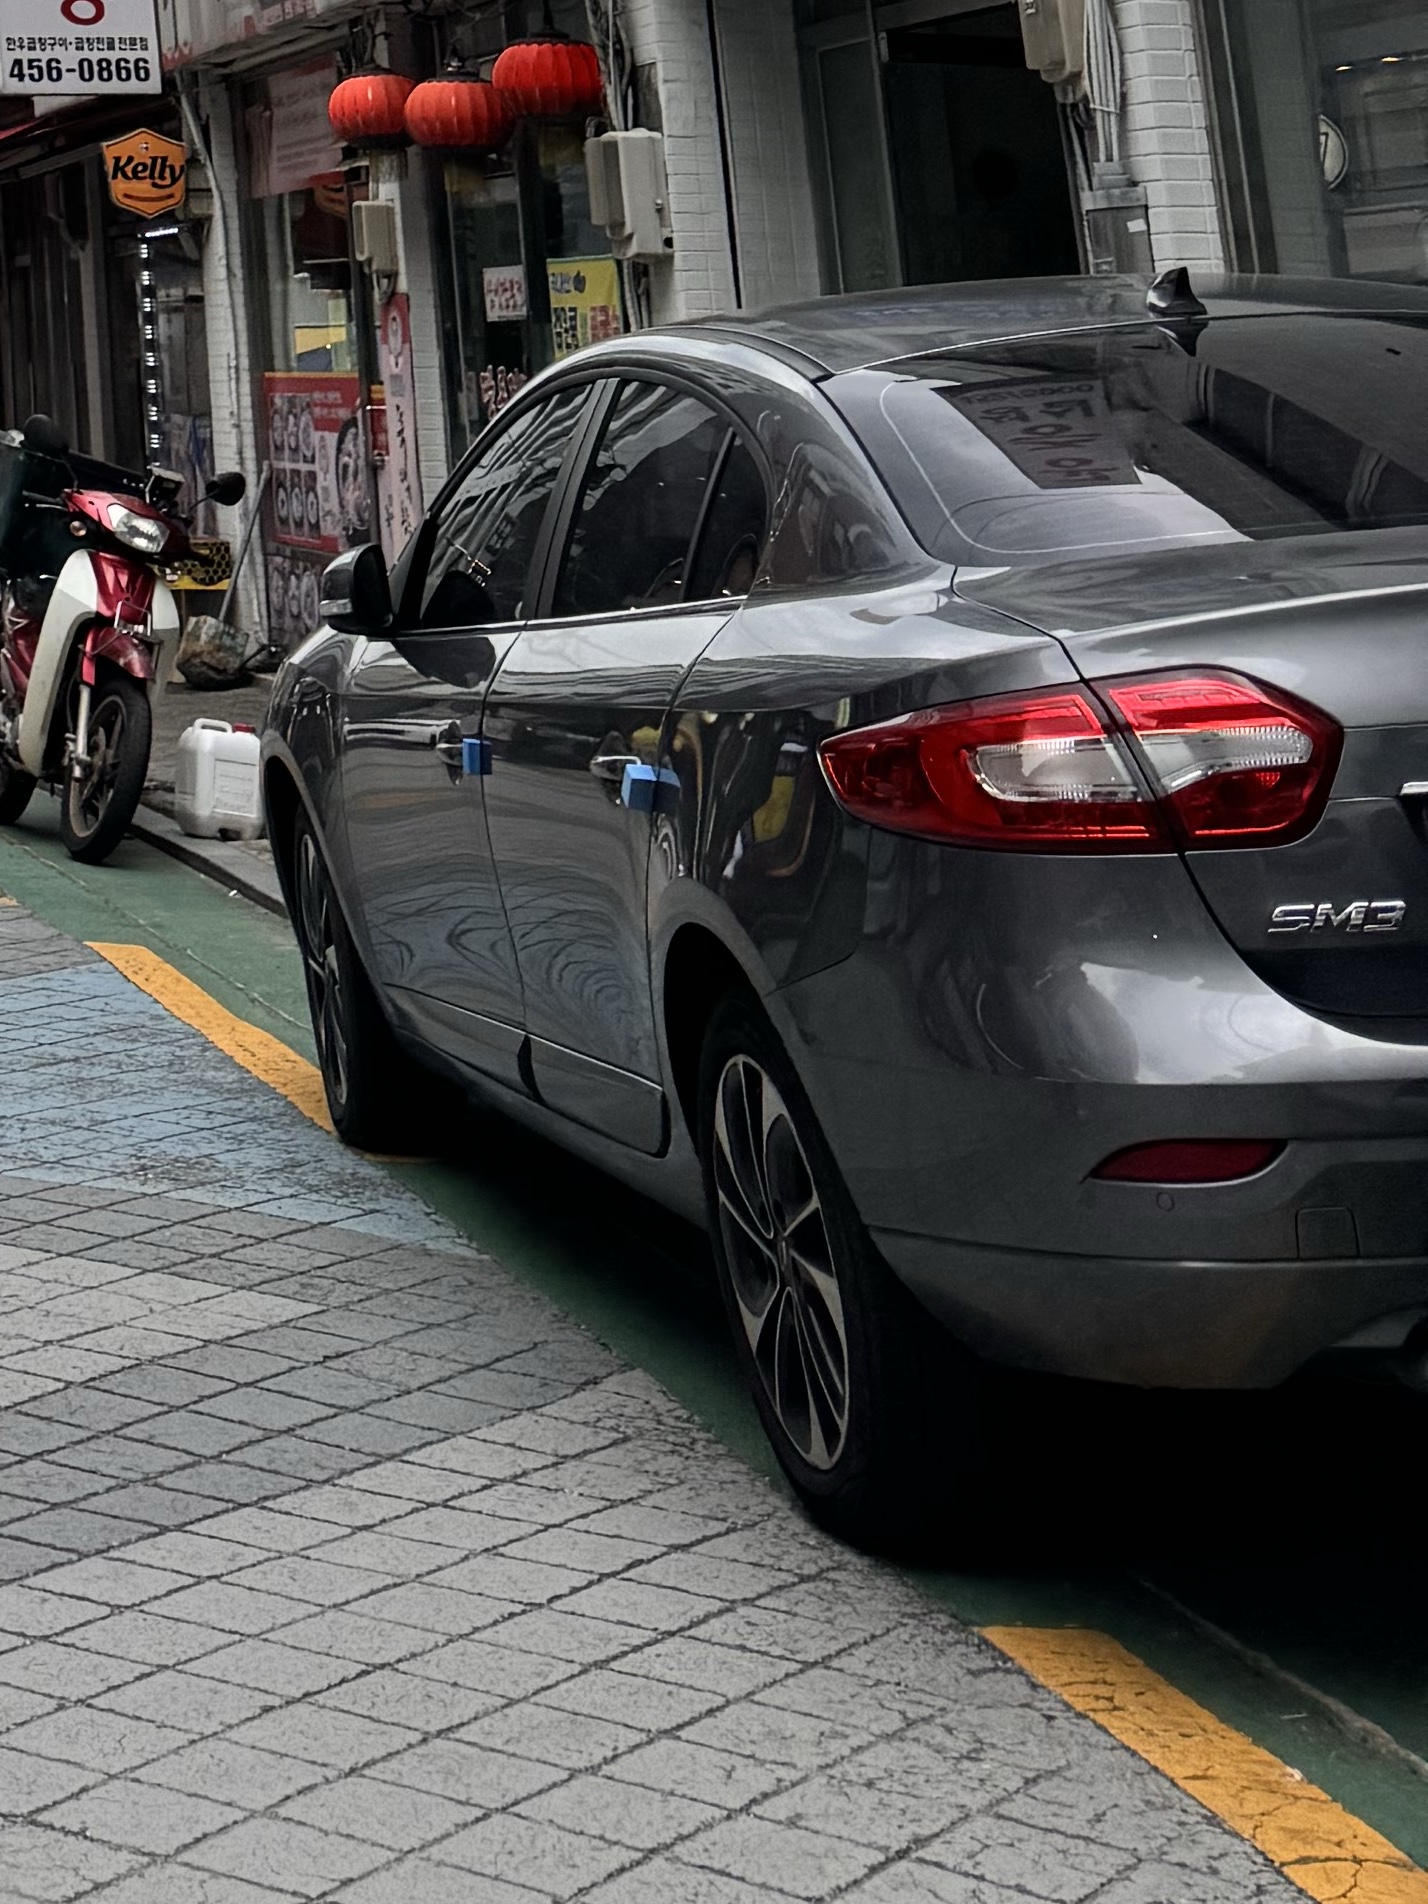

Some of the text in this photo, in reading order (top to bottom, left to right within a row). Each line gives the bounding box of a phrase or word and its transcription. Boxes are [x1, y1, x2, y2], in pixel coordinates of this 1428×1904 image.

[8, 57, 152, 84] 456-0866
[109, 151, 186, 191] Kelly
[1266, 899, 1408, 935] SM3
